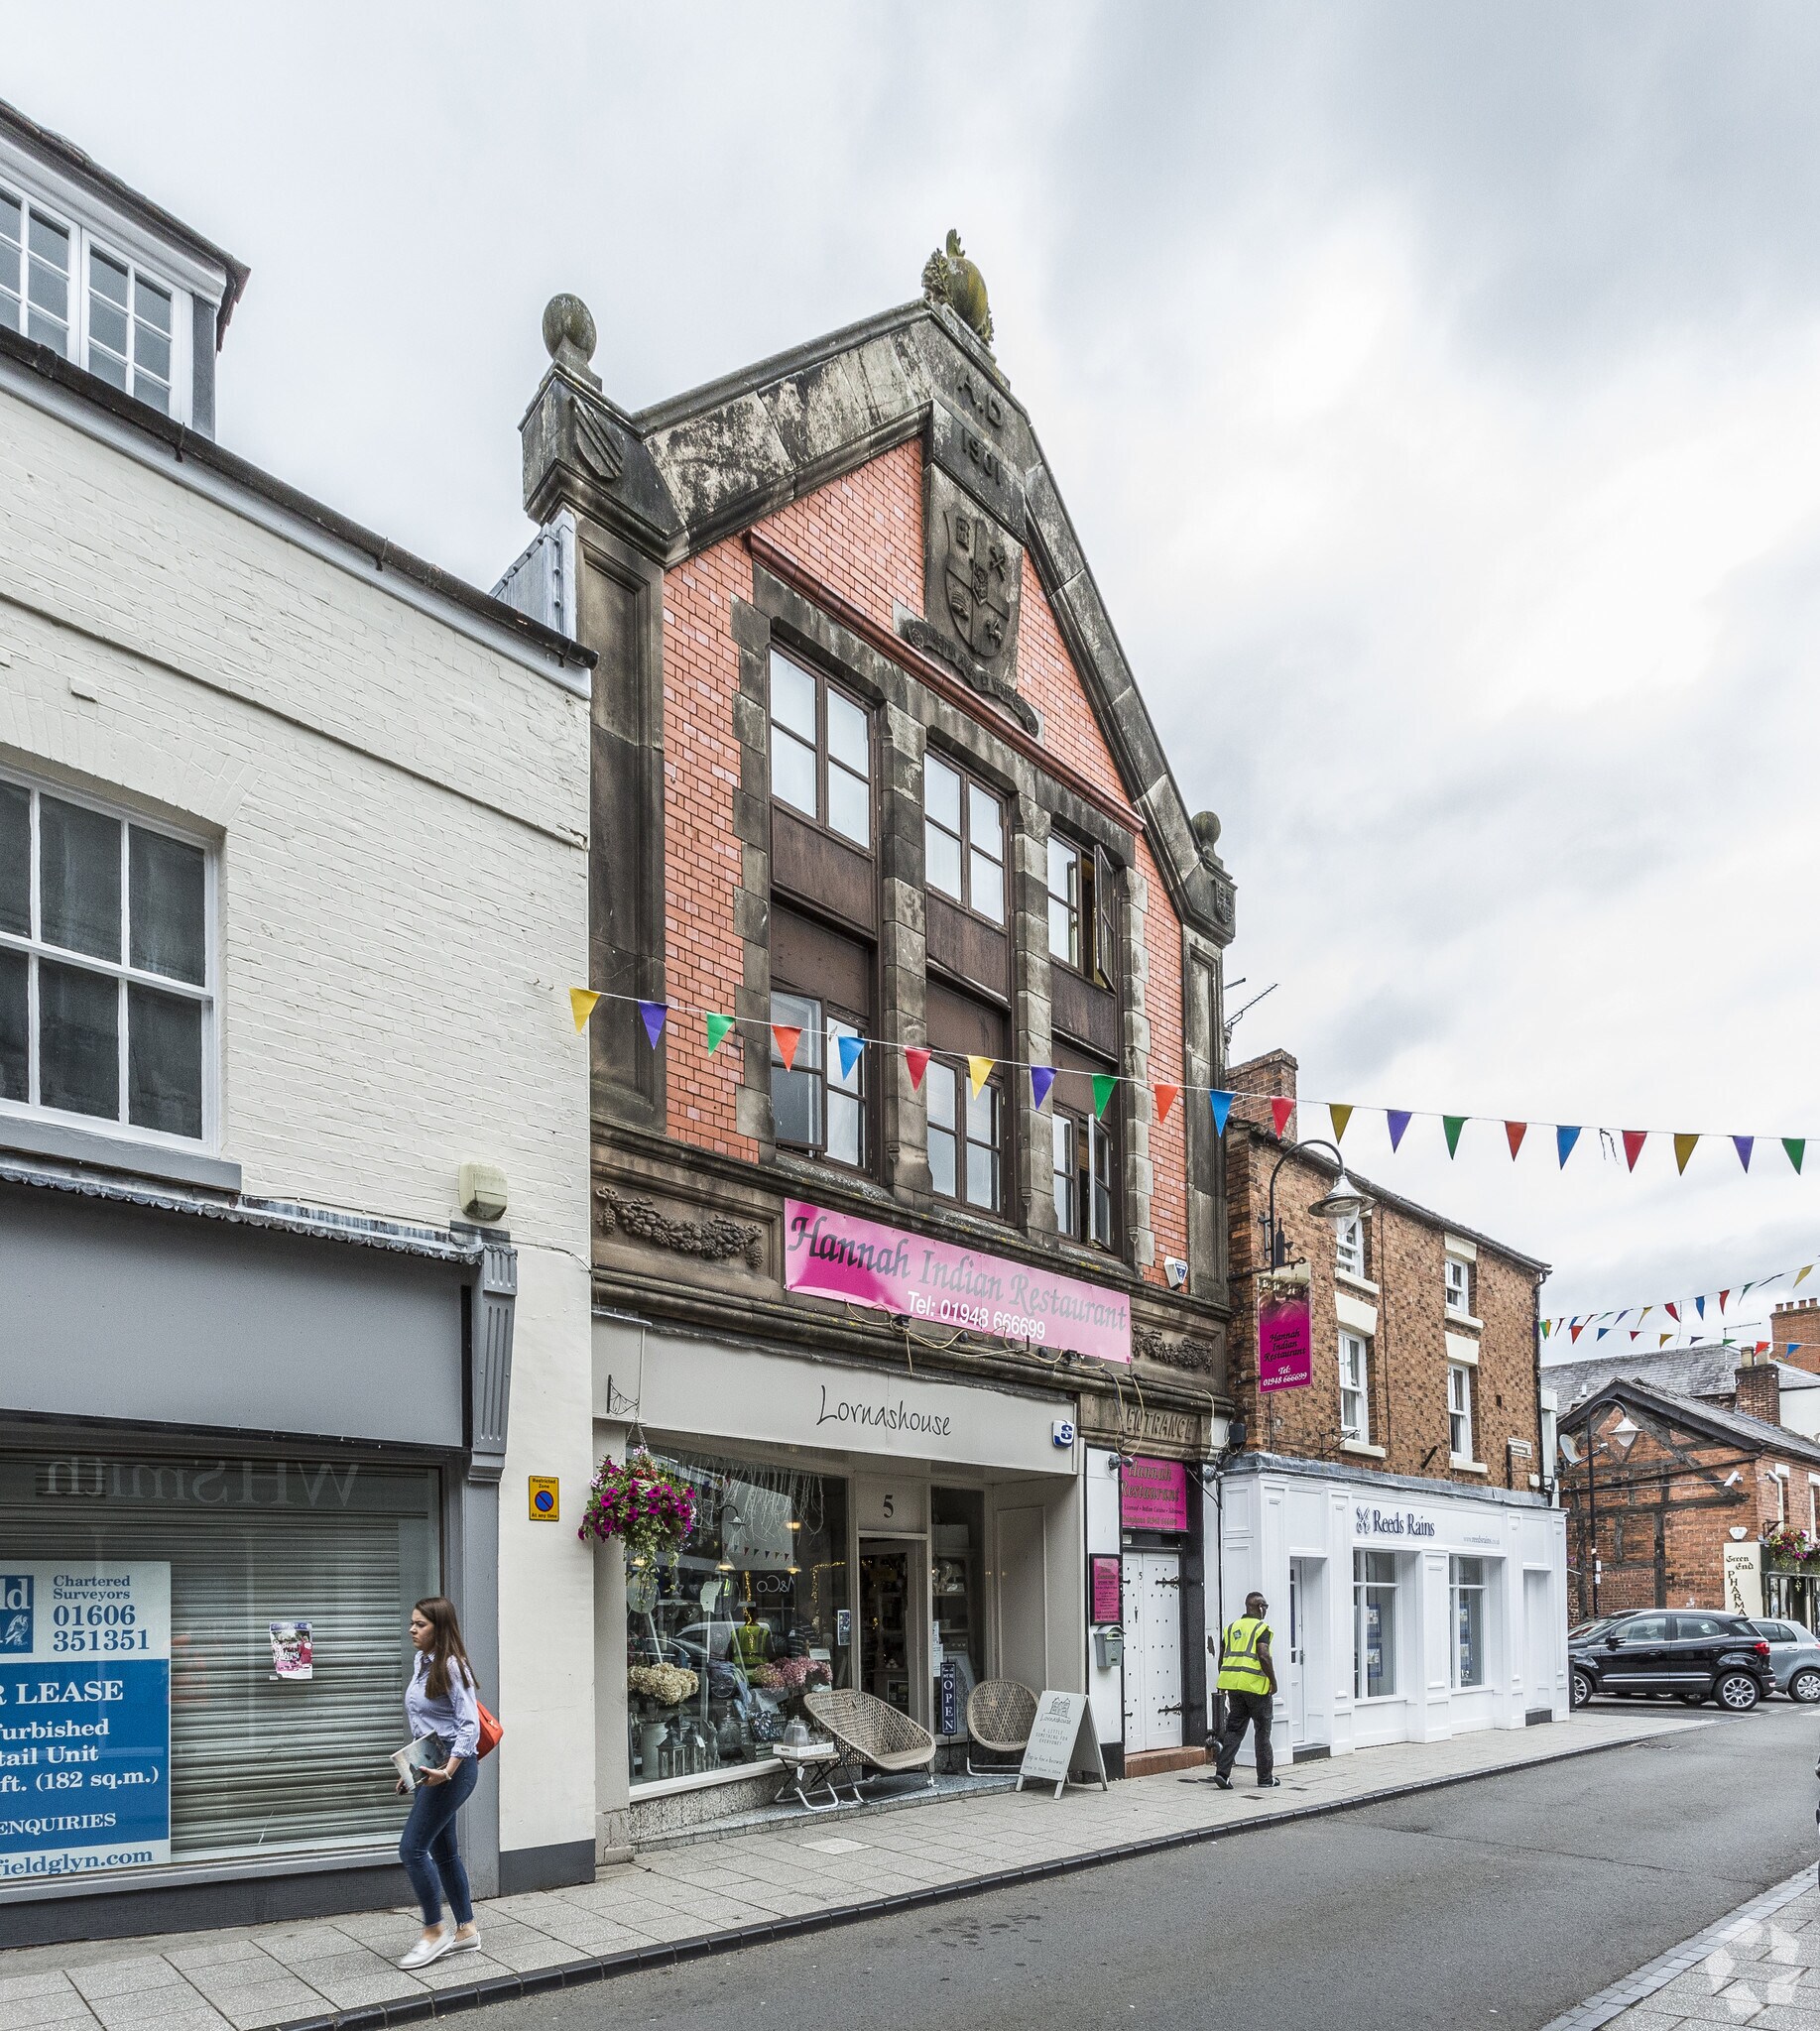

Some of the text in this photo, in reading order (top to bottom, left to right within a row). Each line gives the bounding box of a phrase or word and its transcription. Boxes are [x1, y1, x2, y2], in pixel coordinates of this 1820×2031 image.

[787, 1216, 1128, 1332] Hannah Indian Restaurant
[907, 1290, 1045, 1340] Tel: 01948 666699
[1269, 1329, 1300, 1342] Hannah
[1273, 1341, 1297, 1352] Indian
[1264, 1348, 1306, 1362] Restaurant
[1263, 1373, 1308, 1386] 01948 666699
[1277, 1365, 1291, 1374] Tel:
[816, 1384, 952, 1436] Lornashouse
[1127, 1408, 1195, 1439] ENTRANCE
[1128, 1460, 1171, 1482] Hannah
[1121, 1481, 1180, 1502] Restaurant
[883, 1494, 894, 1518] 5
[1374, 1509, 1435, 1537] Reeds Rains
[53, 1575, 131, 1588] Chartered
[53, 1588, 130, 1603] Surveyors
[53, 1605, 136, 1626] 01606
[53, 1628, 150, 1652] 351351
[16, 1680, 124, 1705] LEASE
[943, 1679, 954, 1731] OPEN
[46, 1744, 99, 1764] Unit
[0, 1765, 160, 1793] ft. (182 sq.m.)
[0, 1812, 117, 1836] ENQUIRIES
